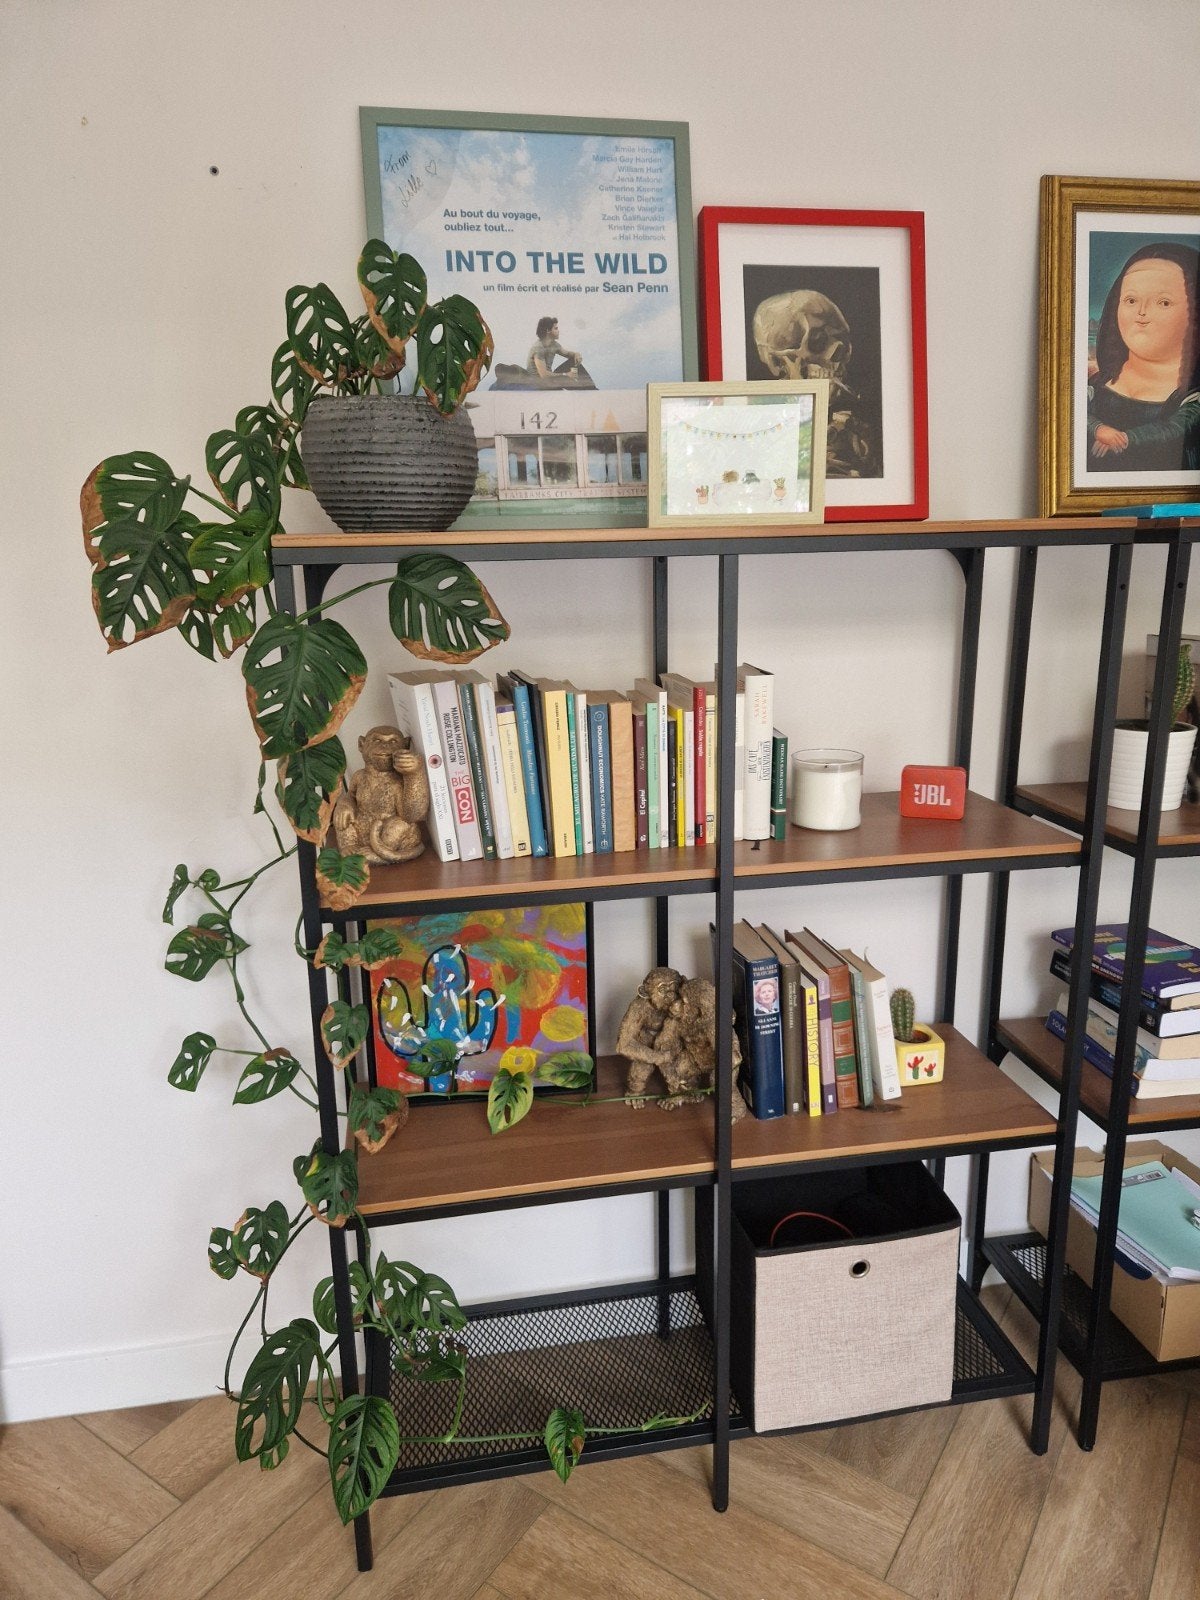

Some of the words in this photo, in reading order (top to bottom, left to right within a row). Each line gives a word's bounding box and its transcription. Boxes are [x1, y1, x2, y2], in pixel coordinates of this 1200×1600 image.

[598, 184, 634, 192] Catherine
[444, 208, 457, 218] Au
[460, 209, 484, 218] bout
[486, 210, 499, 219] du
[502, 212, 541, 222] voyage,
[444, 222, 480, 232] oubliez
[484, 224, 514, 232] tout...
[446, 250, 517, 273] INTO
[526, 252, 585, 274] THE
[594, 252, 668, 274] WILD
[497, 284, 514, 292] film
[517, 284, 538, 292] écrit
[540, 284, 550, 292] et
[552, 284, 582, 292] réalisé
[584, 286, 600, 294] par
[602, 282, 633, 294] Sean
[638, 282, 668, 293] Penn
[520, 412, 558, 430] 142
[443, 713, 452, 730] ROSIE
[451, 707, 461, 733] MARIANA
[445, 730, 456, 763] COLLINGTON
[455, 734, 466, 766] MAZZUCATO
[569, 731, 577, 771] GUADALUPE
[451, 775, 470, 787] BIG
[572, 772, 578, 782] DE
[572, 783, 580, 816] MILAGRO
[638, 789, 646, 808] Capital
[914, 784, 951, 806] JBL
[456, 790, 473, 823] CON
[752, 964, 778, 972] MARGARET
[753, 969, 778, 977] THATCHER
[807, 1018, 819, 1066] HISTORY
